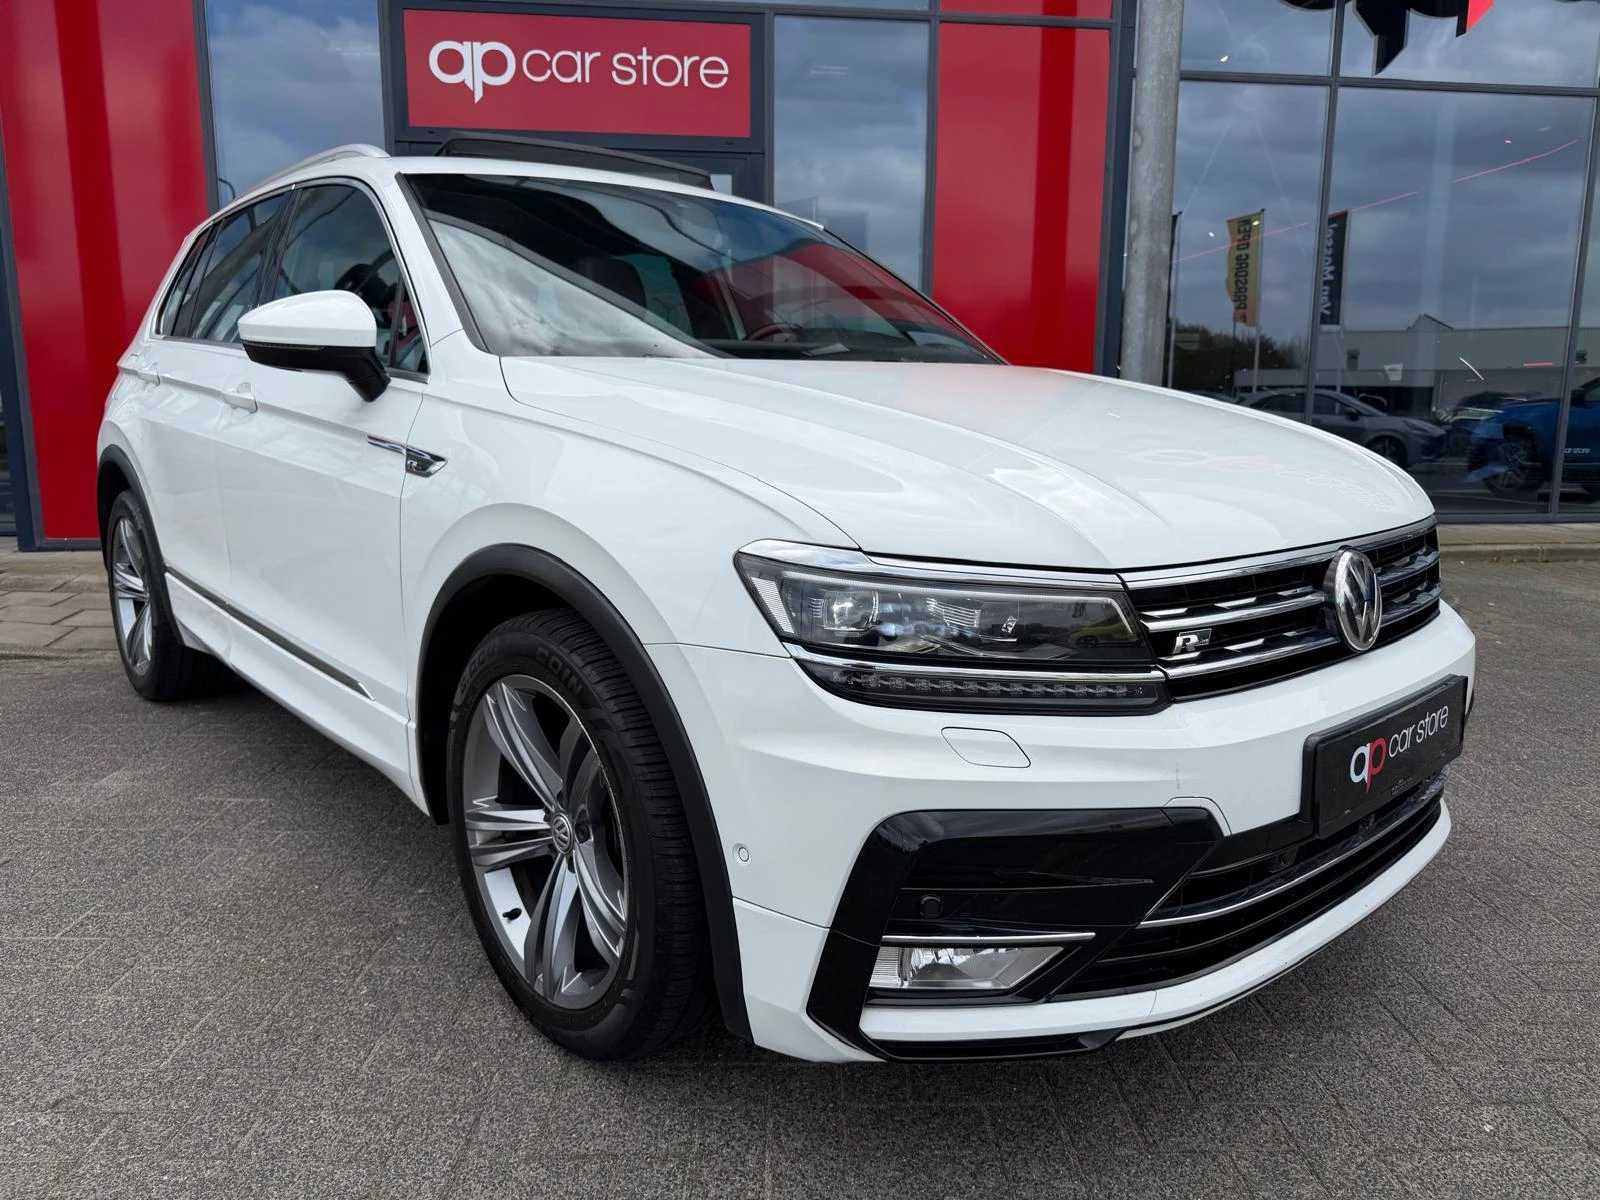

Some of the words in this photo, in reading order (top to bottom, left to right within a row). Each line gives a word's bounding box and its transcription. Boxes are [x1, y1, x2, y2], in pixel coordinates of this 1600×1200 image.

[428, 40, 517, 105] ap
[522, 49, 602, 84] car
[611, 47, 730, 90] store
[1350, 737, 1387, 793] ap
[1388, 724, 1415, 758] car
[1416, 705, 1449, 744] store
